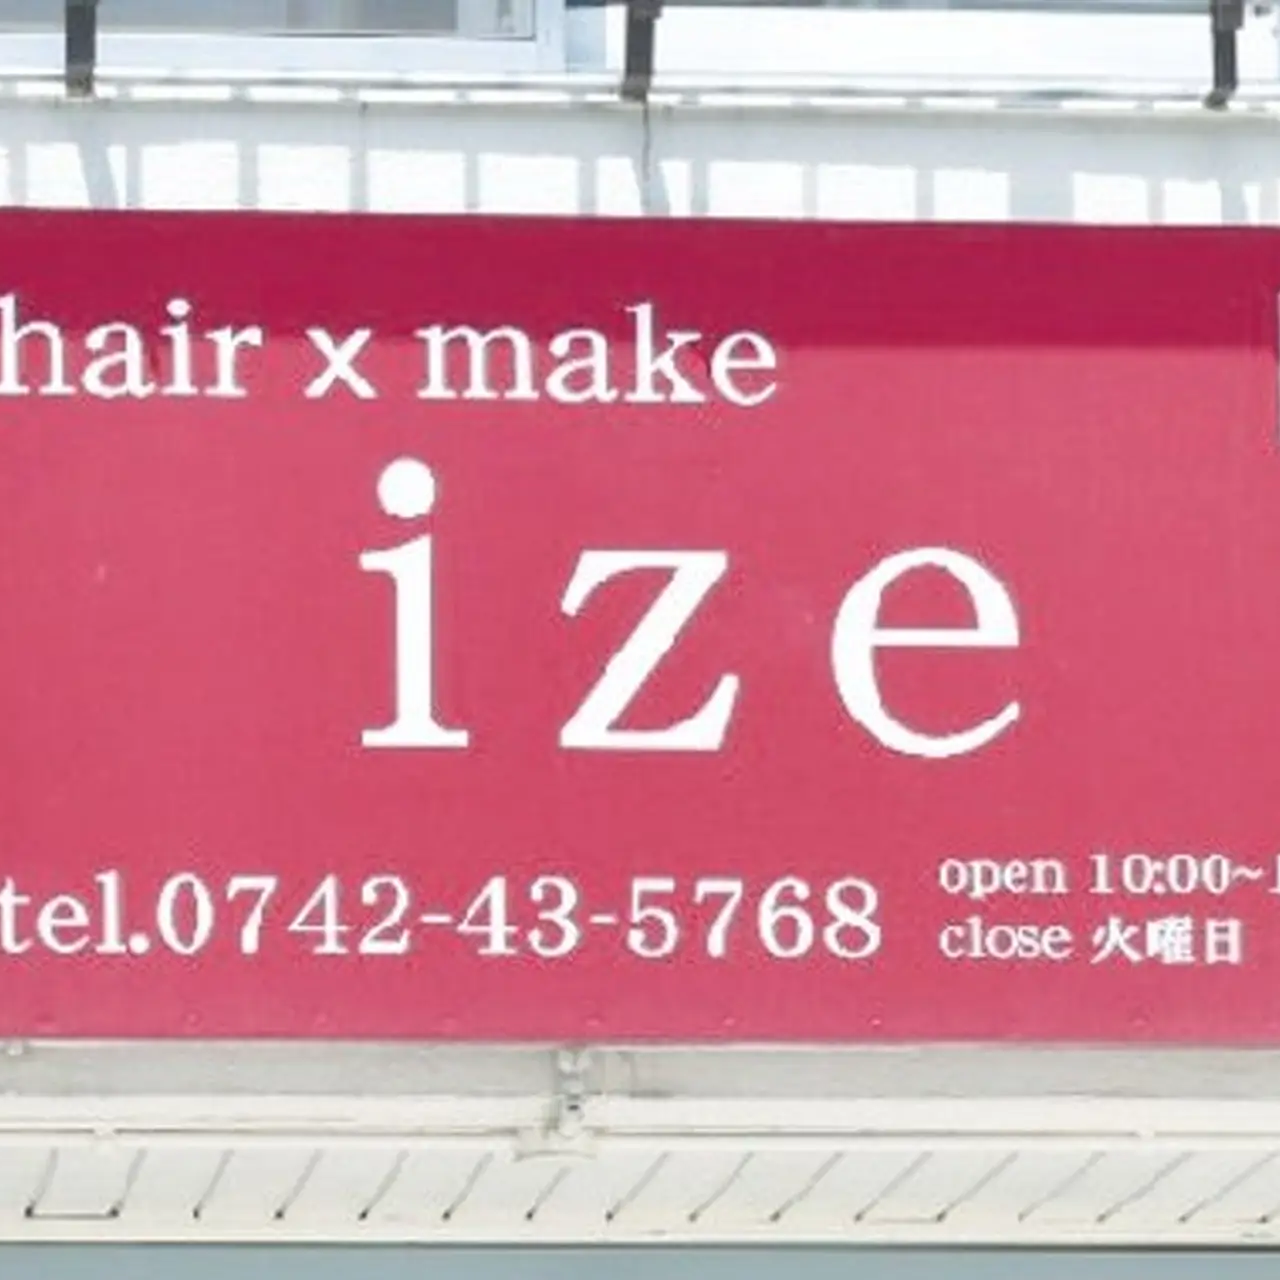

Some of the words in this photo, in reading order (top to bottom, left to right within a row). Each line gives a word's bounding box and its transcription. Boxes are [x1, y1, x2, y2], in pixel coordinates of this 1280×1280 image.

[417, 302, 779, 408] make
[358, 457, 1024, 760] ize
[938, 858, 1068, 902] open
[938, 914, 1073, 962] close
[1090, 914, 1244, 966] 火曜日
